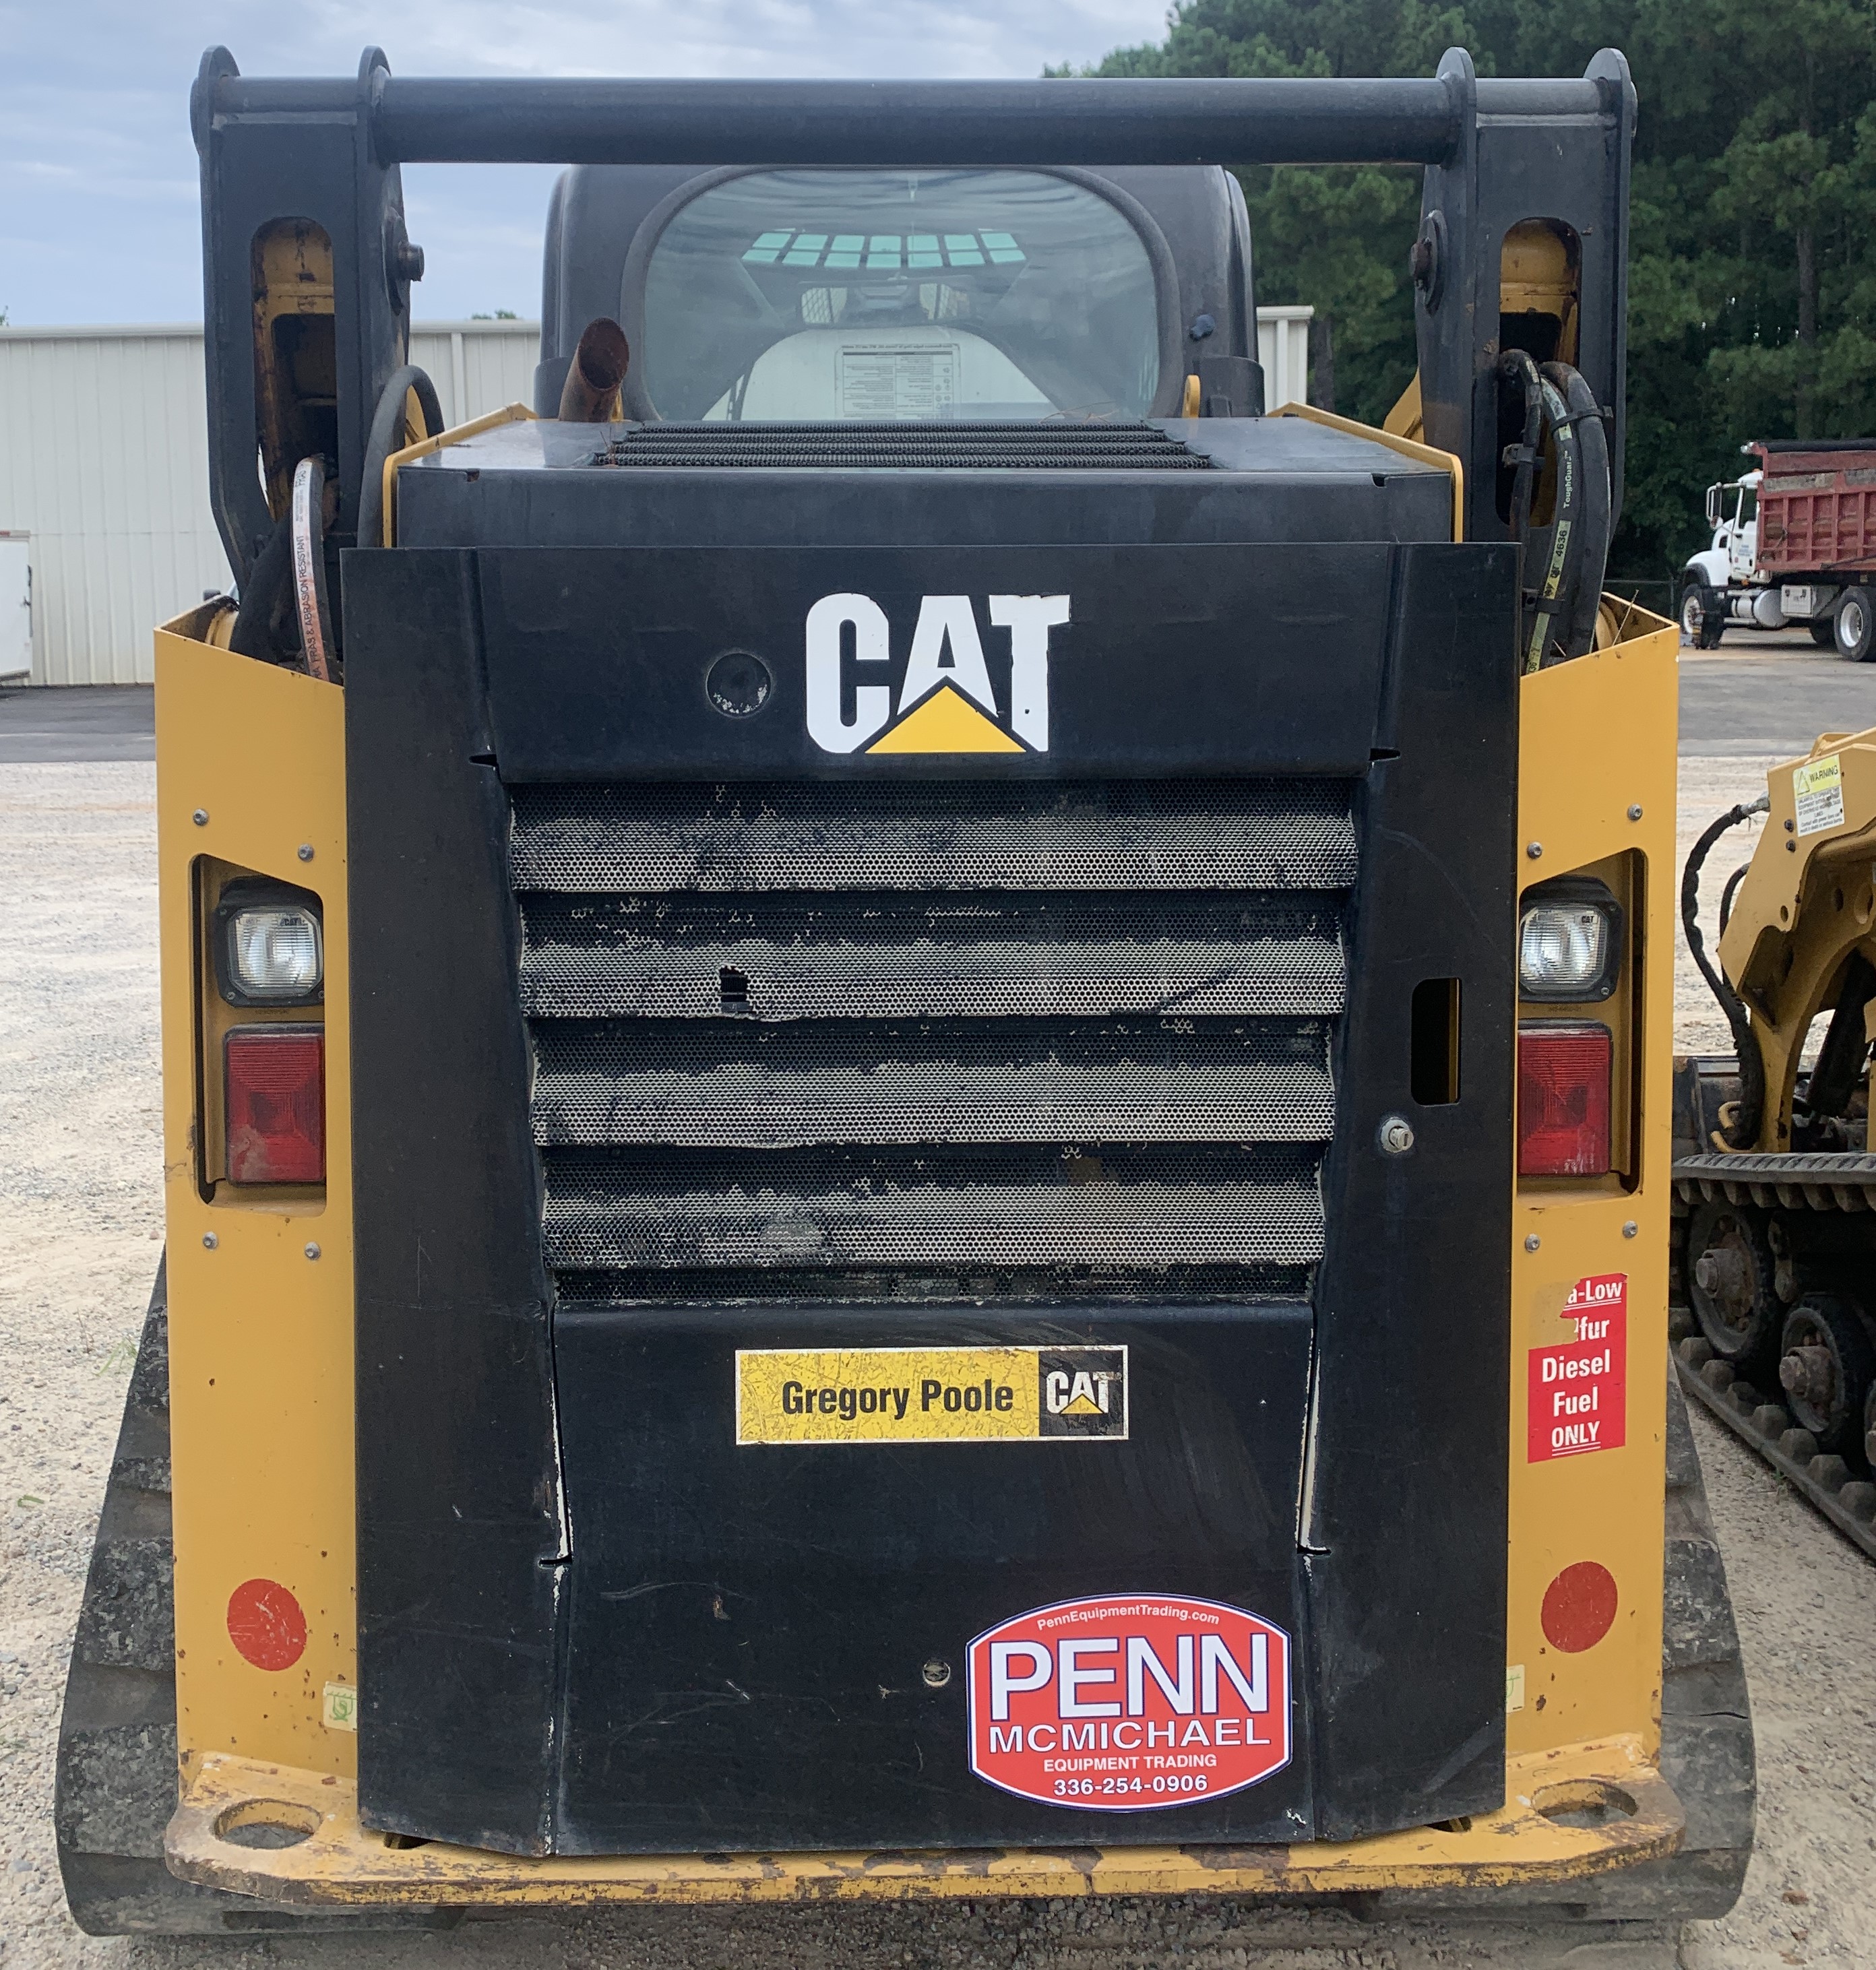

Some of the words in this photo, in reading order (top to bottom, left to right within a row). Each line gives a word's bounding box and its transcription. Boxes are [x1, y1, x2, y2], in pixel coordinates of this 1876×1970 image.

[296, 535, 307, 578] RESISTANT
[1555, 530, 1567, 557] 4636
[299, 579, 313, 626] ABRASION
[806, 593, 1070, 753] CAT
[1809, 765, 1838, 783] WARNING
[1542, 1348, 1611, 1383] Diesel
[782, 1380, 910, 1421] Gregory
[921, 1378, 1013, 1413] Poole
[1046, 1370, 1116, 1414] CAT
[1553, 1385, 1598, 1418] Fuel
[1551, 1420, 1601, 1449] ONLY
[1036, 1603, 1220, 1631] PennEquipmentTrading.com
[989, 1633, 1270, 1721] PENN
[989, 1718, 1272, 1754] MCMICHAEL
[1043, 1757, 1139, 1773] EQUIPMENT
[1144, 1754, 1218, 1769] TRADING
[1053, 1775, 1208, 1796] 336-254-0906
